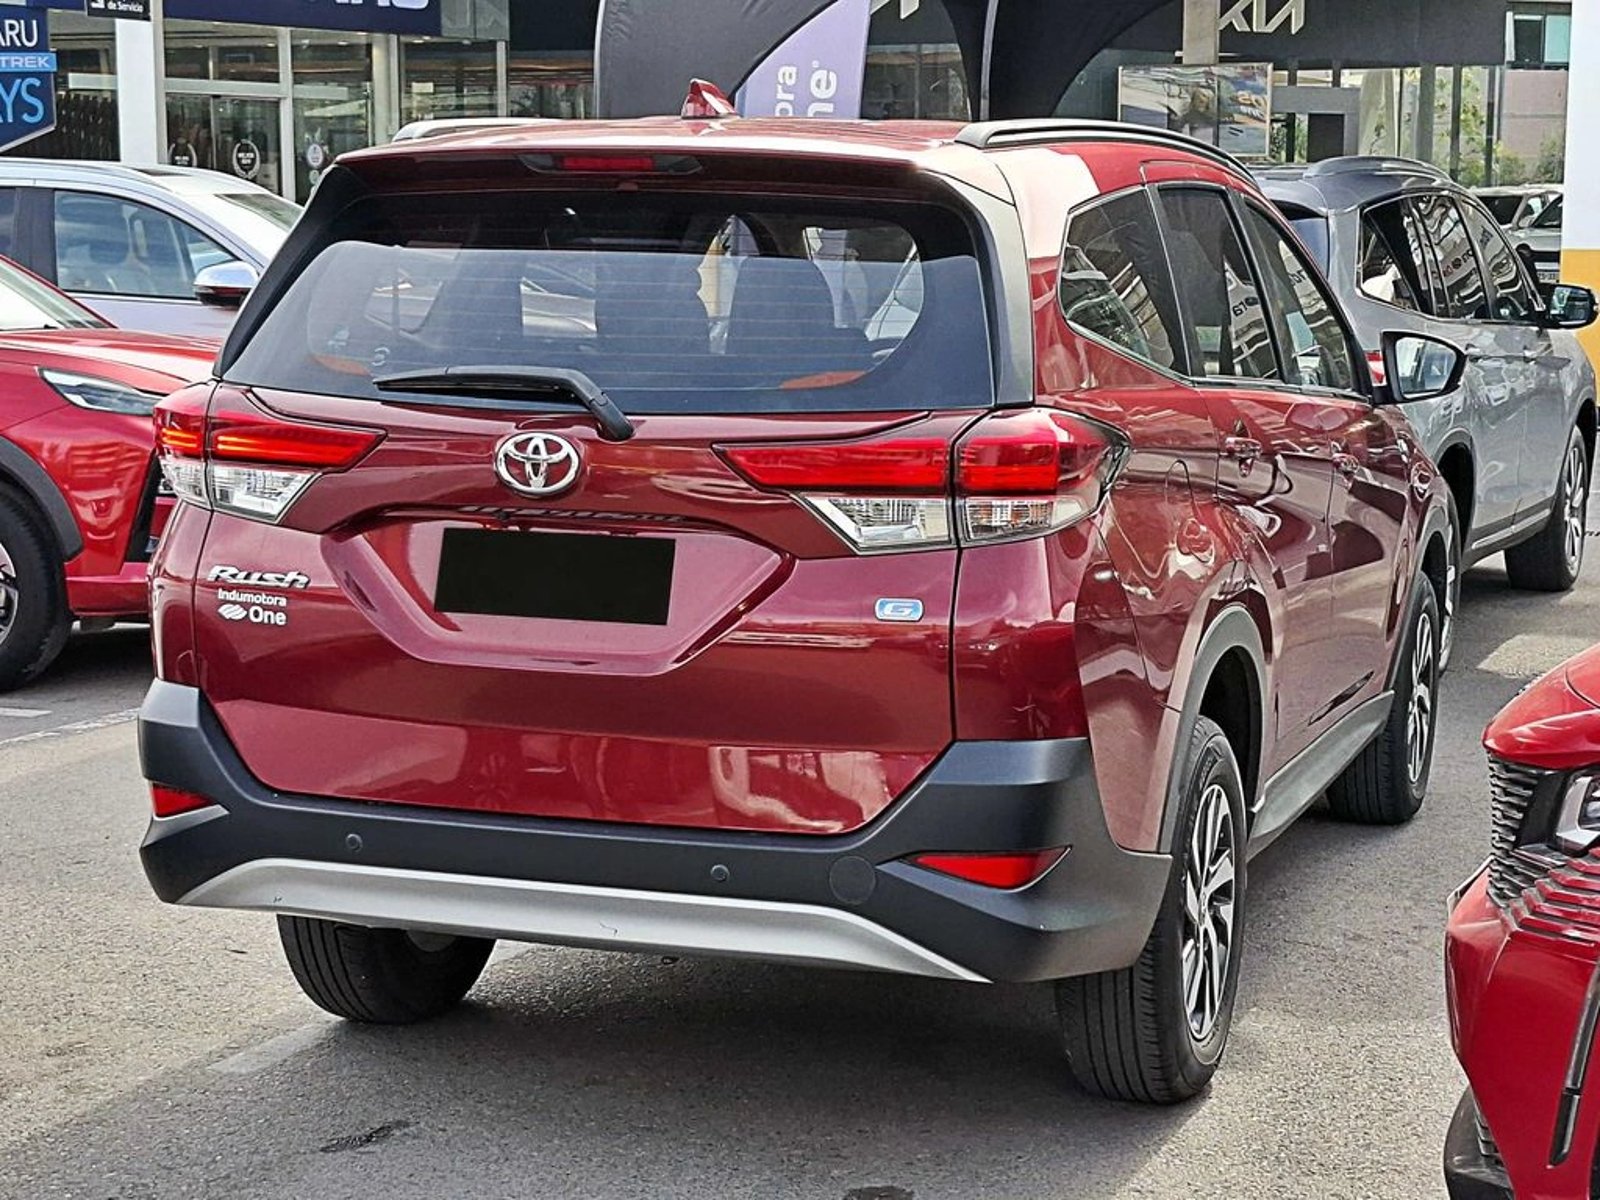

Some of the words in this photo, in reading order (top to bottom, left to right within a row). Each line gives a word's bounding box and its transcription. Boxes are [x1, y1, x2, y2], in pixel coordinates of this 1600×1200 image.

[0, 19, 38, 47] RU
[0, 77, 44, 123] YS
[206, 565, 311, 588] Rush
[217, 588, 287, 607] Indumotora
[248, 606, 287, 625] One
